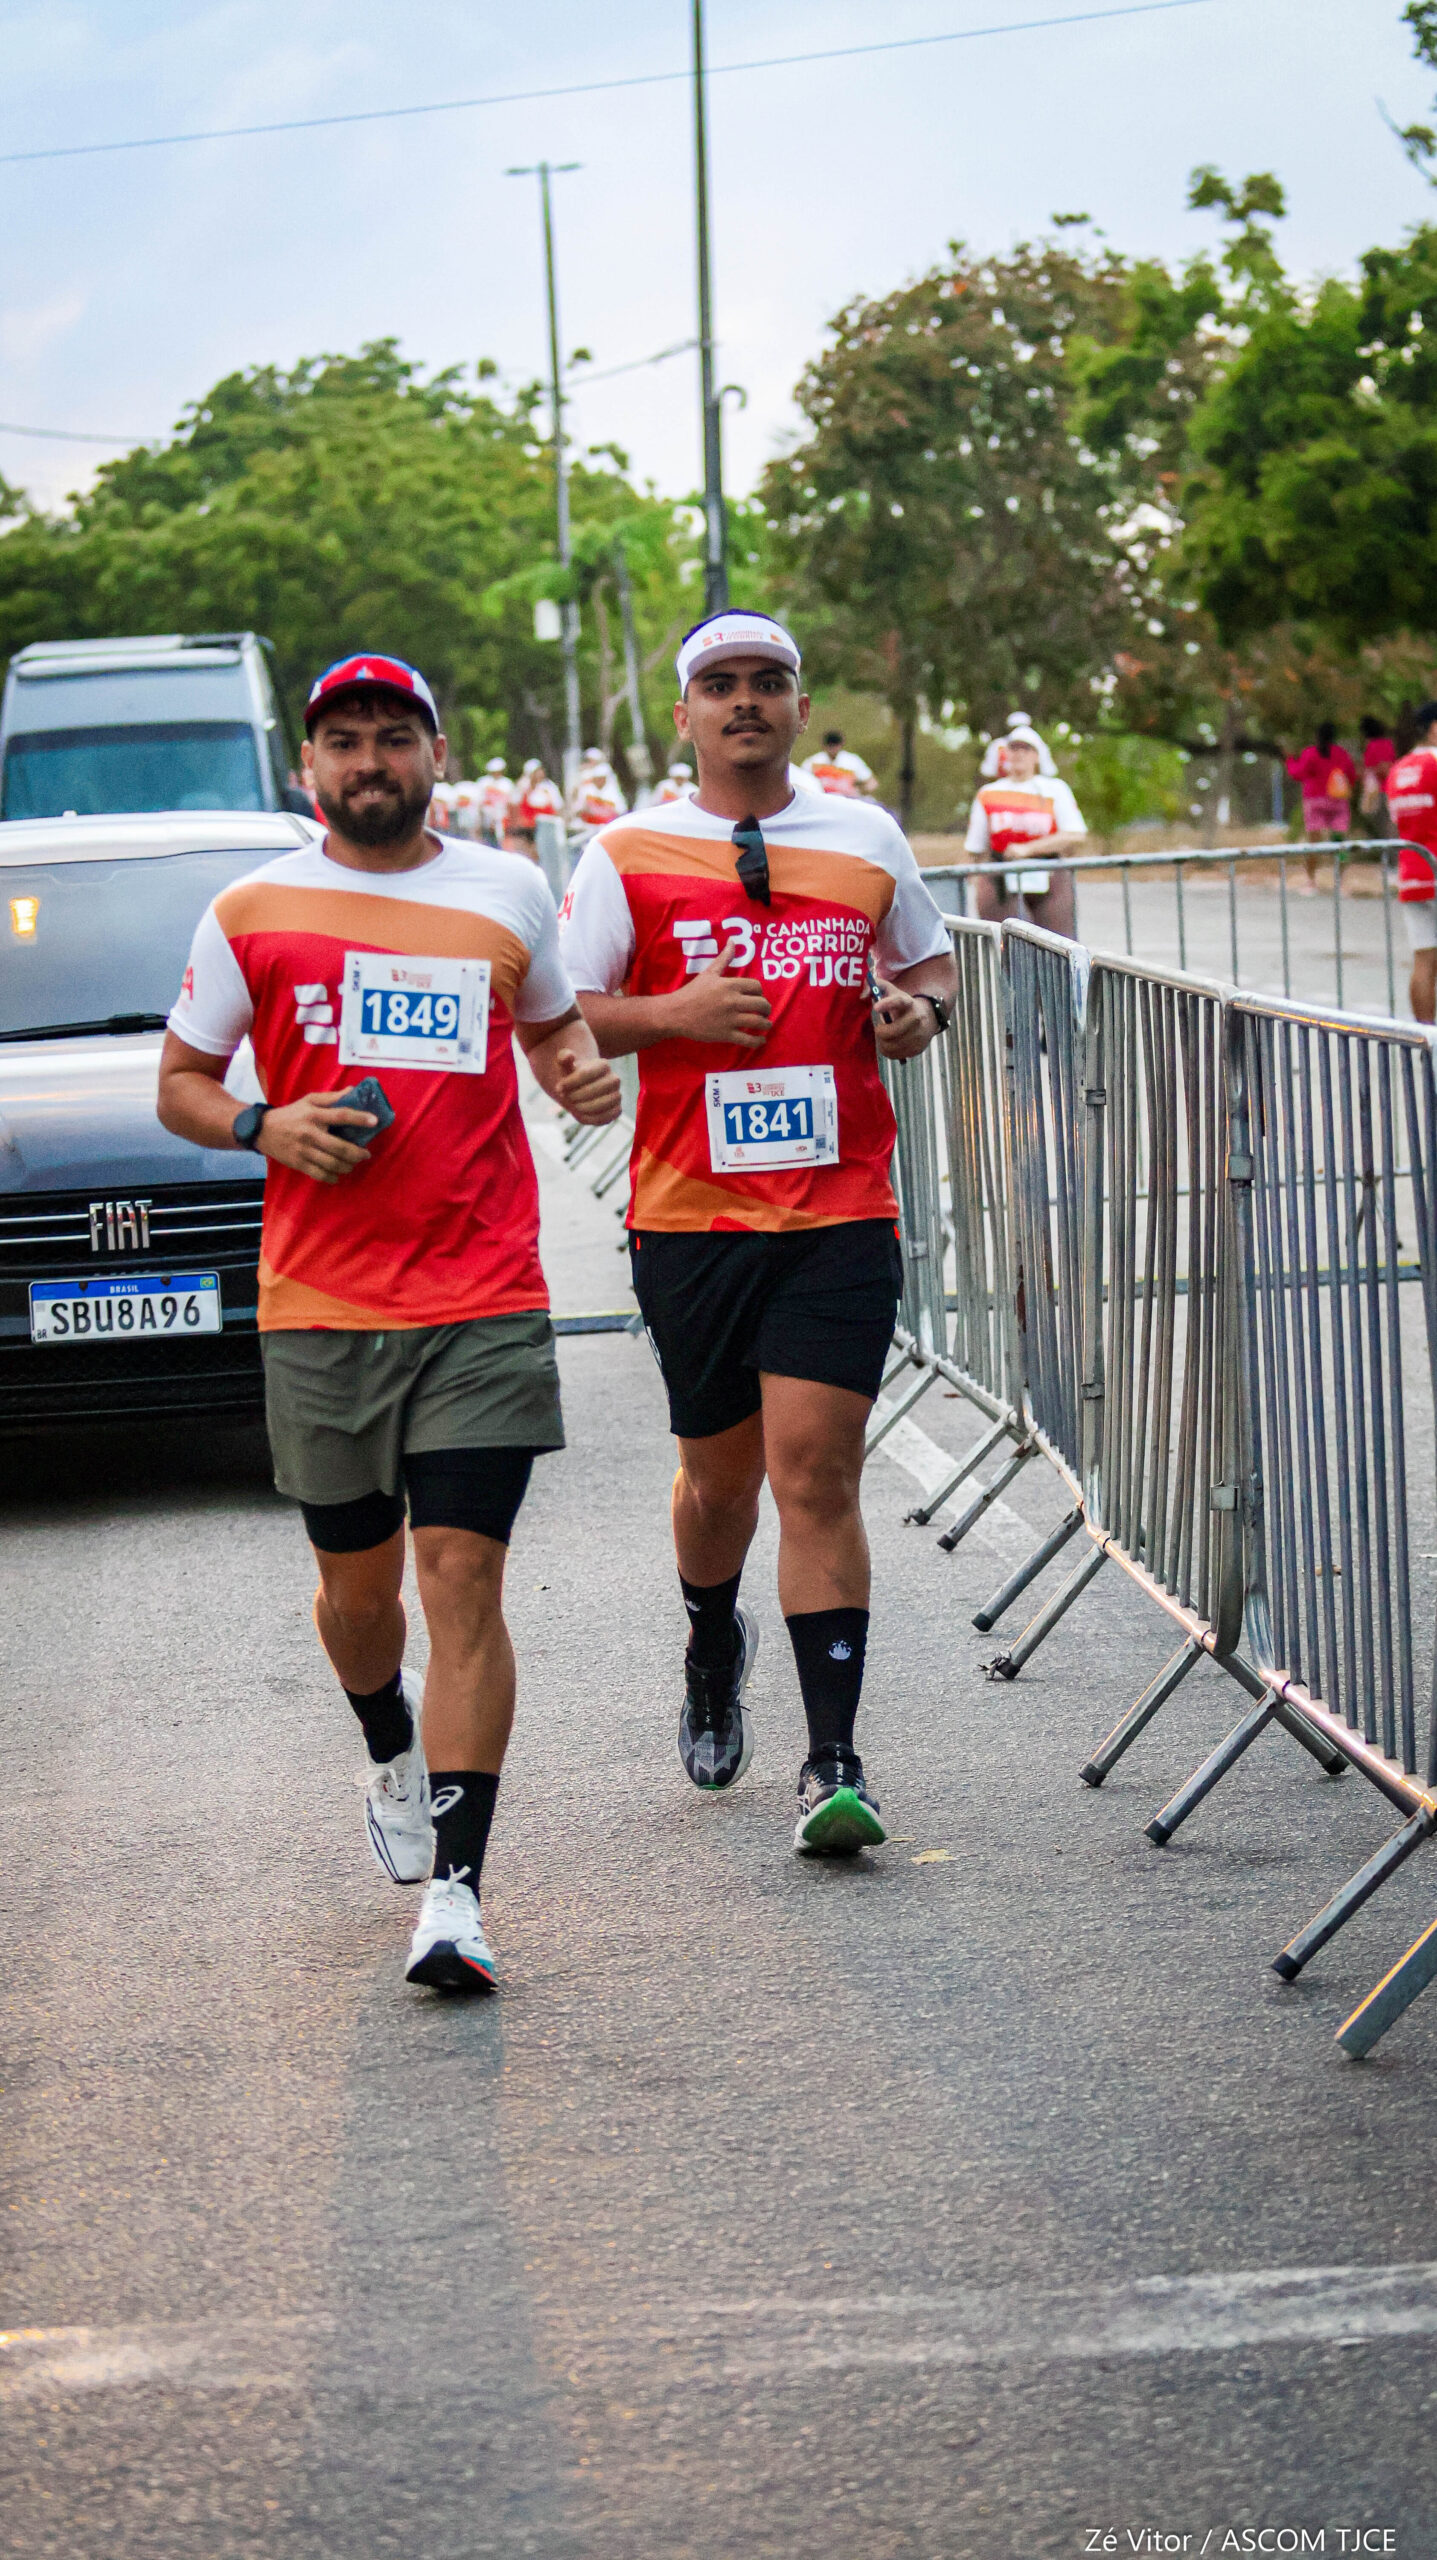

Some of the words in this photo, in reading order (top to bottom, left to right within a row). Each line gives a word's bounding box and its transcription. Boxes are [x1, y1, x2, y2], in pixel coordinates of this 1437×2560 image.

[766, 917, 870, 938] CAMINHADA
[762, 957, 801, 981] DO
[803, 955, 864, 987] TJCE
[365, 992, 458, 1037] 1849
[713, 1088, 721, 1108] 5KM
[727, 1101, 808, 1141] 1841
[89, 1199, 153, 1252] FIAT
[109, 1284, 139, 1294] BRASIL
[51, 1295, 200, 1335] SBU8A96
[37, 1328, 47, 1339] BR
